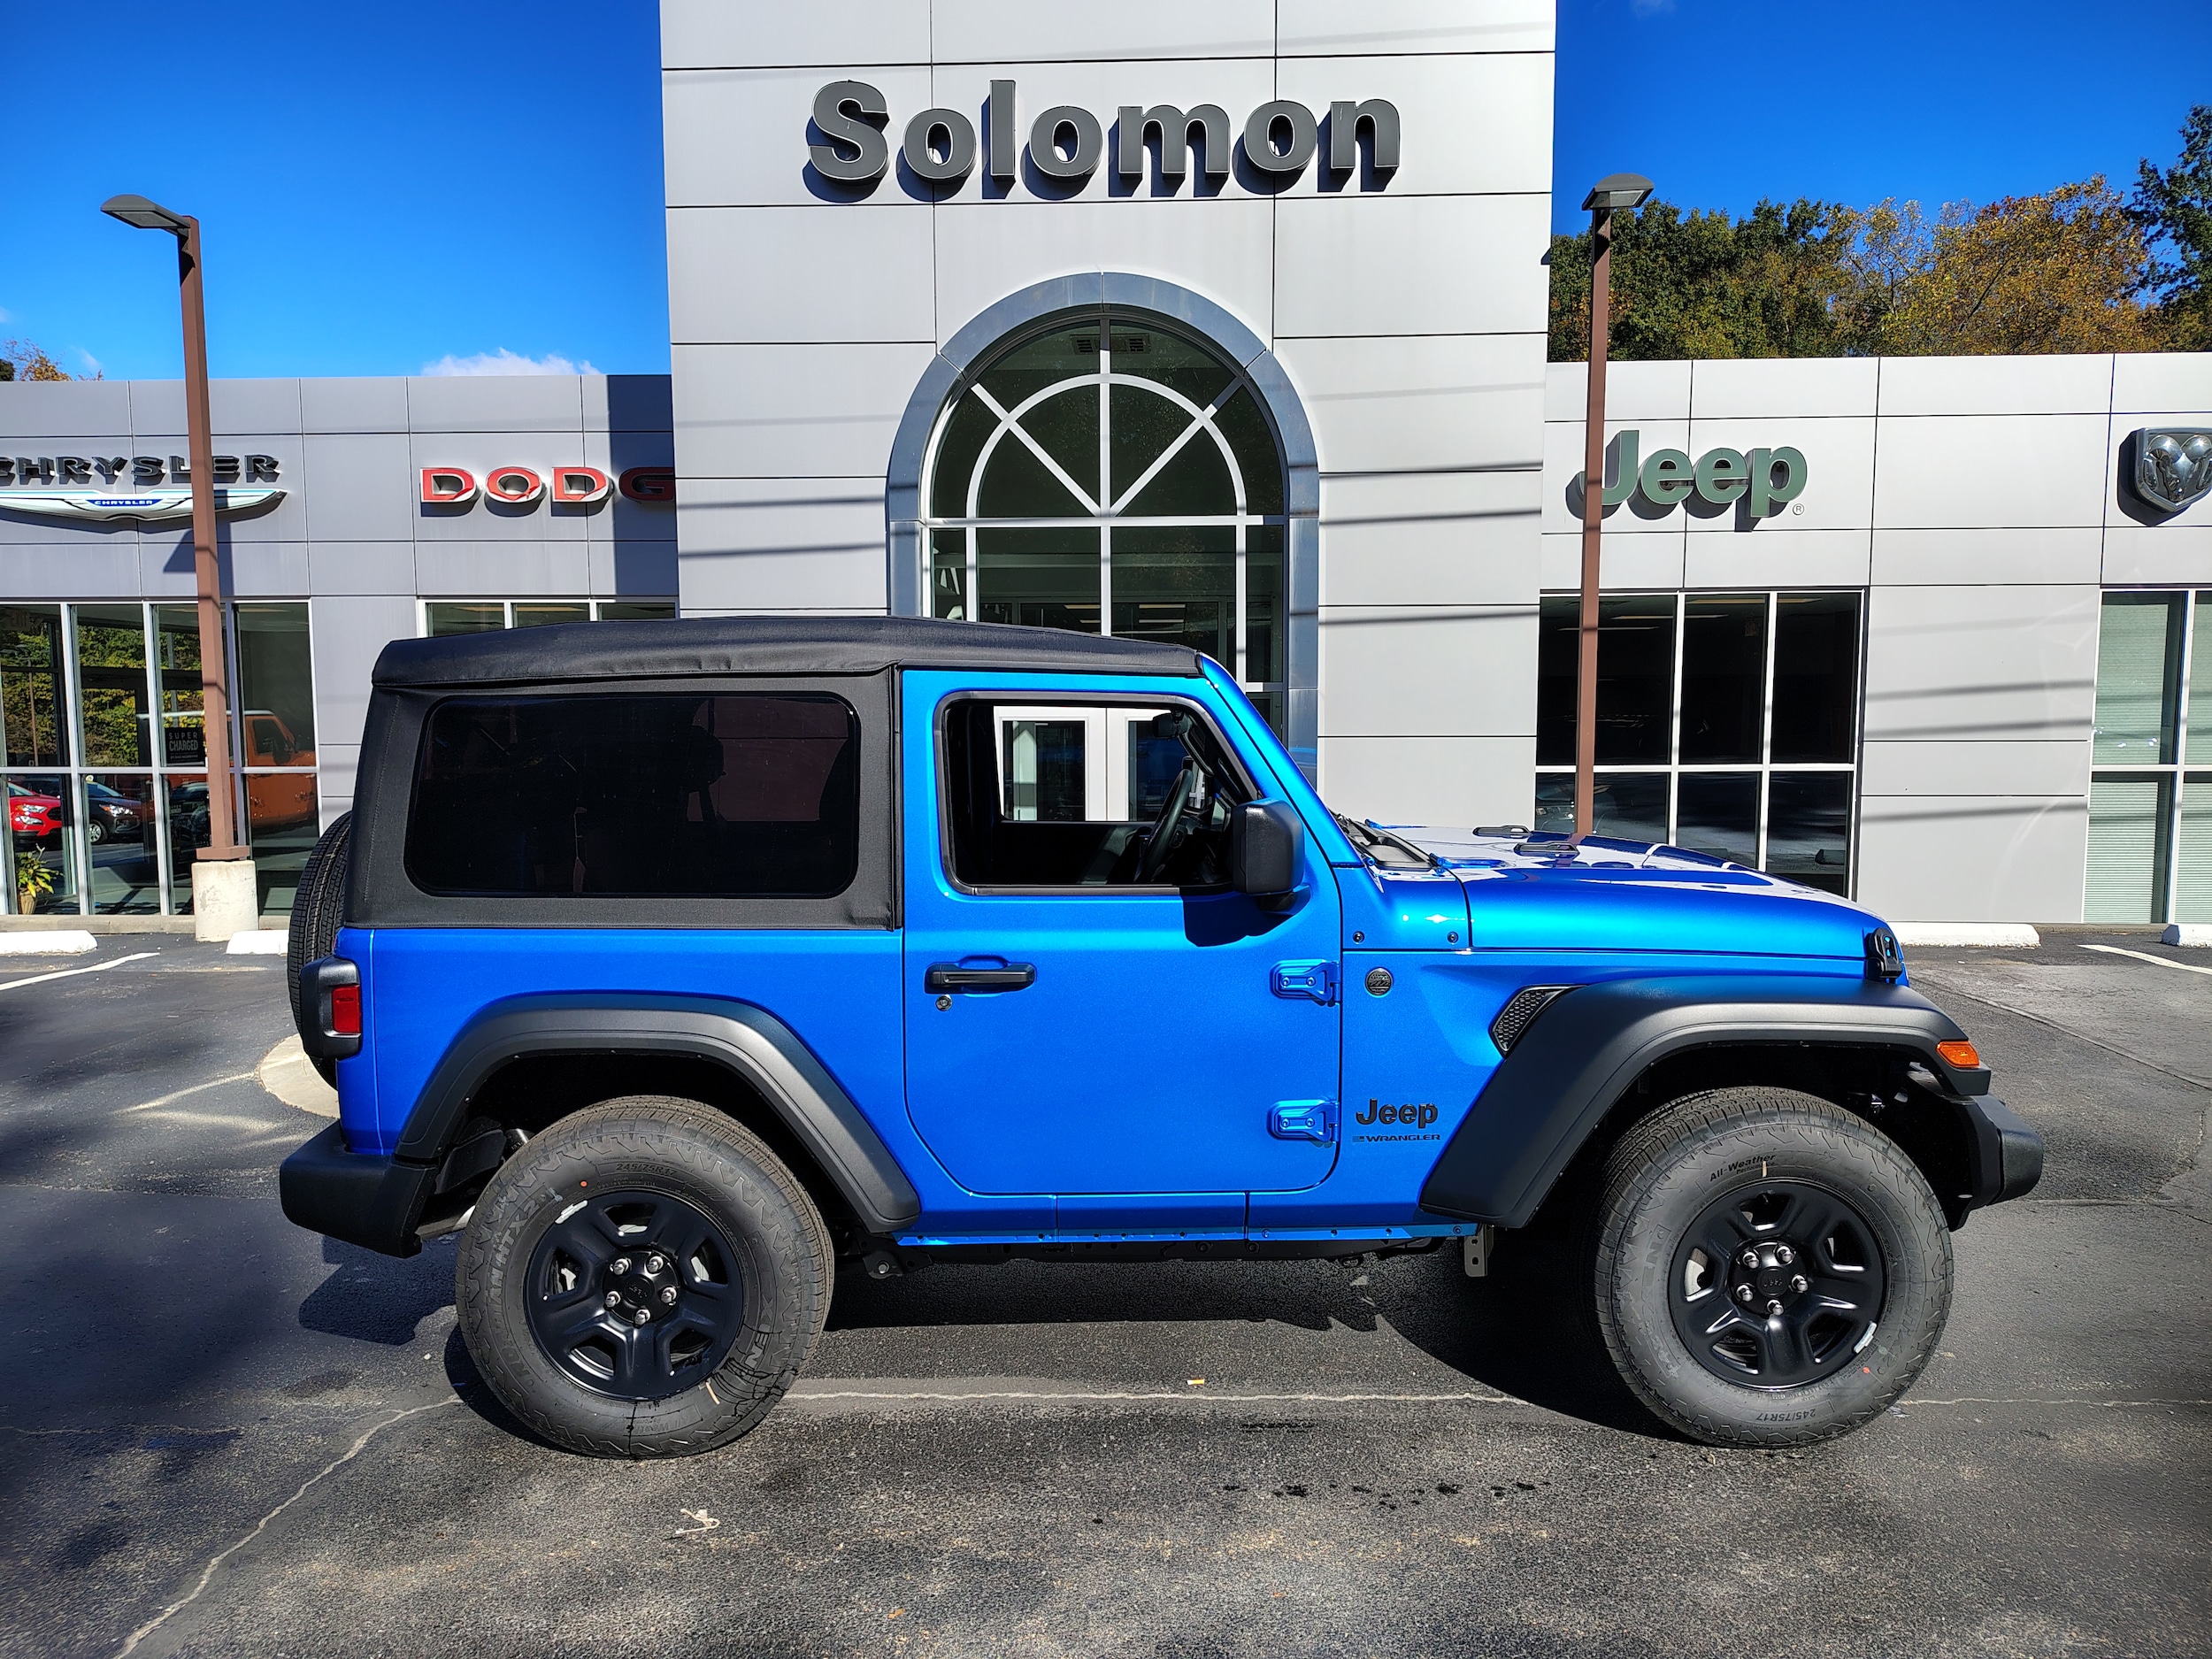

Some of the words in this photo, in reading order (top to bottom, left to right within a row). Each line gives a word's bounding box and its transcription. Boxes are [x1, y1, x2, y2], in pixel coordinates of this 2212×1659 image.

[809, 80, 1400, 180] Solomon
[1578, 429, 1808, 518] Jeep
[169, 740, 198, 751] CHARGED
[1356, 1098, 1438, 1129] Jeep
[615, 1163, 678, 1177] 245/75R17
[1709, 1155, 1776, 1182] All-Weather
[1755, 1407, 1816, 1422] 245/75R17
